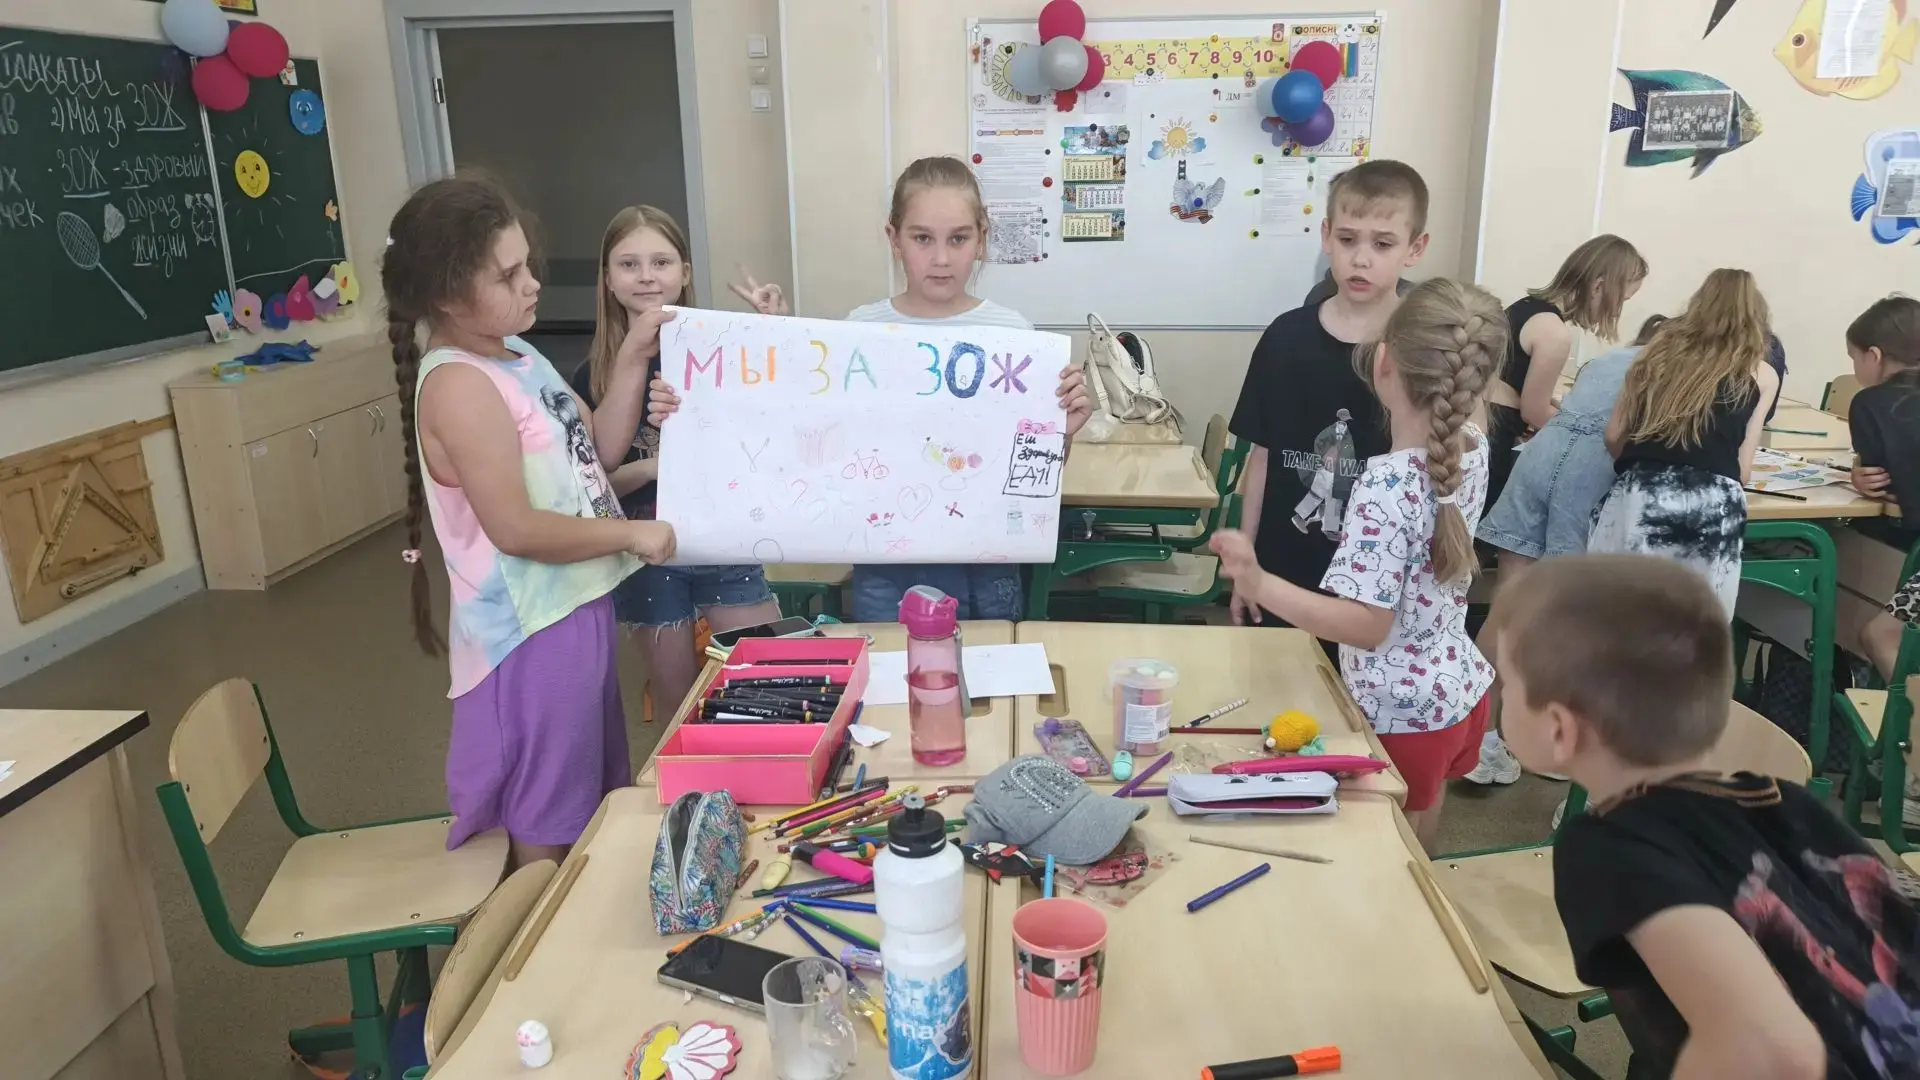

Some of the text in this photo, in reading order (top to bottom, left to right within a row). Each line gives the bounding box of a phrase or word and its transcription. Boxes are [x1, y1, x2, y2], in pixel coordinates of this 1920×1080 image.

[1102, 49, 1273, 67] 3 4 5 6 7 8 9 10
[127, 81, 187, 128] ЗОЖ
[57, 146, 108, 193] ЗОЖ
[684, 340, 1033, 398] МЫ ЗА ЗОЖ
[1282, 449, 1322, 471] TAKE
